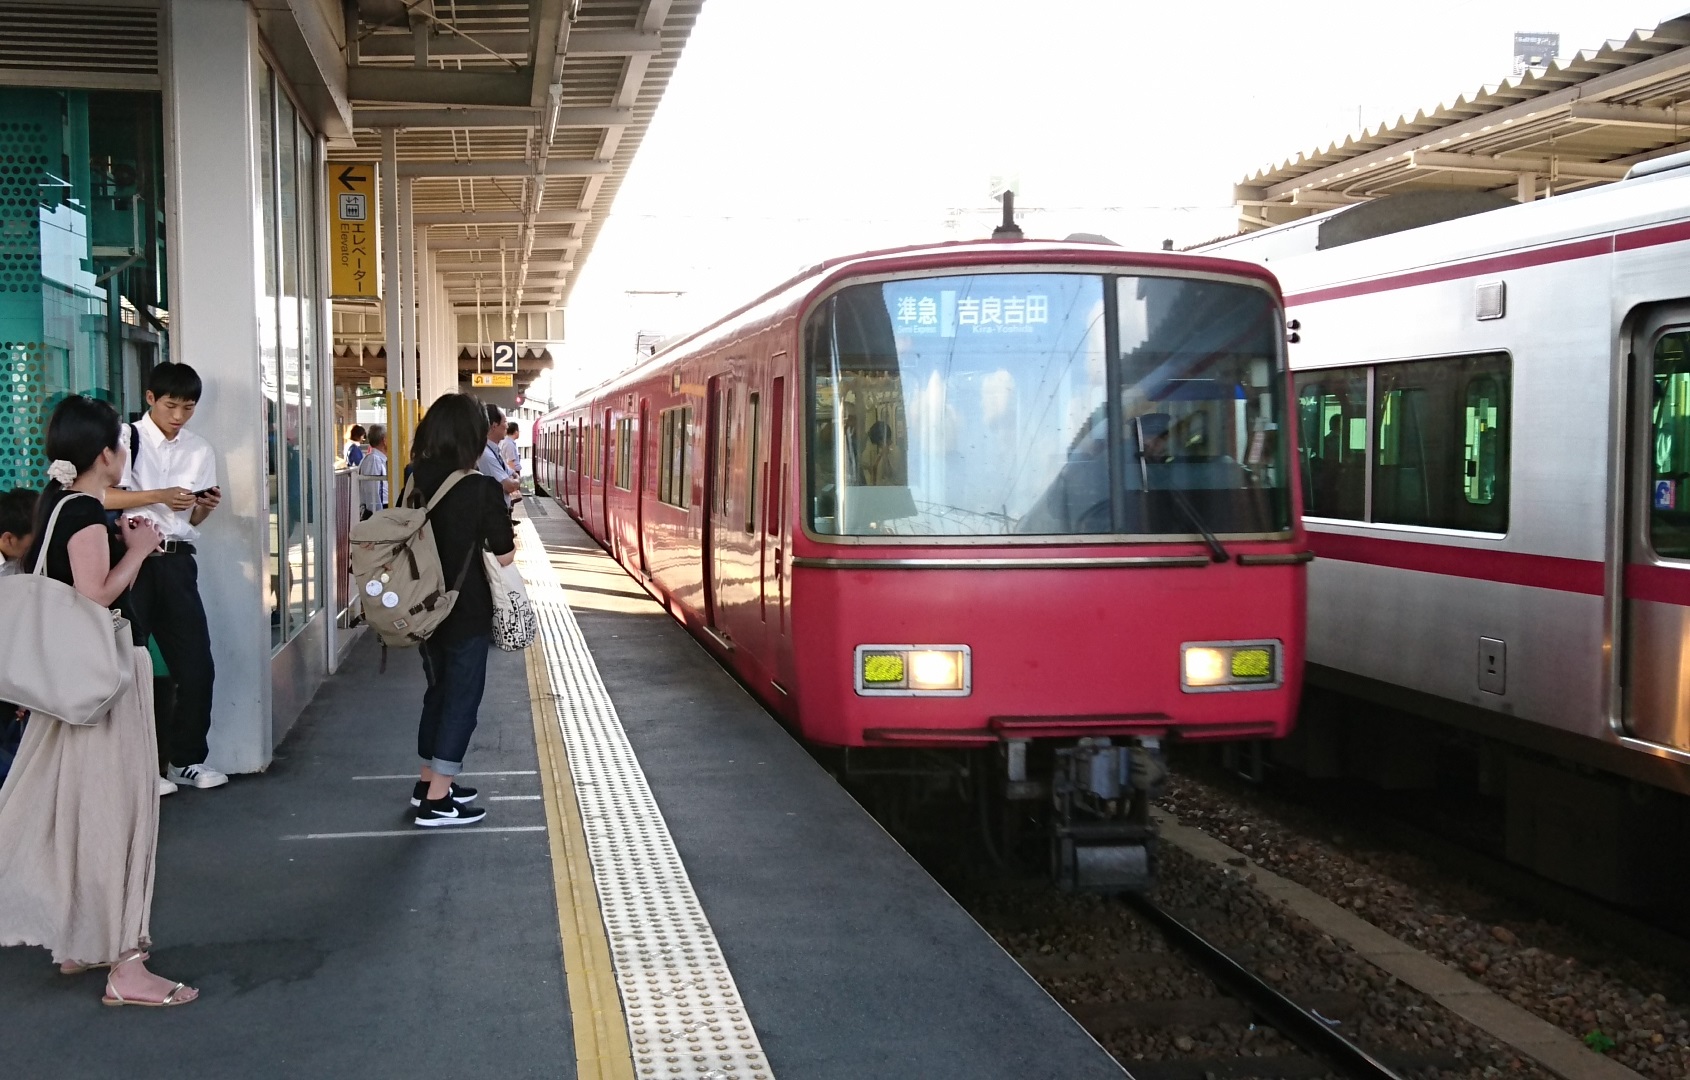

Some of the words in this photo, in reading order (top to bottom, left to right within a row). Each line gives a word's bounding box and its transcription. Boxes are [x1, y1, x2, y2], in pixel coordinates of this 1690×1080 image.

[340, 223, 350, 267] Elevator
[352, 223, 366, 292] エレベーター
[897, 296, 938, 325] 準急
[958, 295, 1048, 325] 吉良吉田
[972, 325, 1033, 333] Kira-Yoshida
[495, 345, 513, 367] 2
